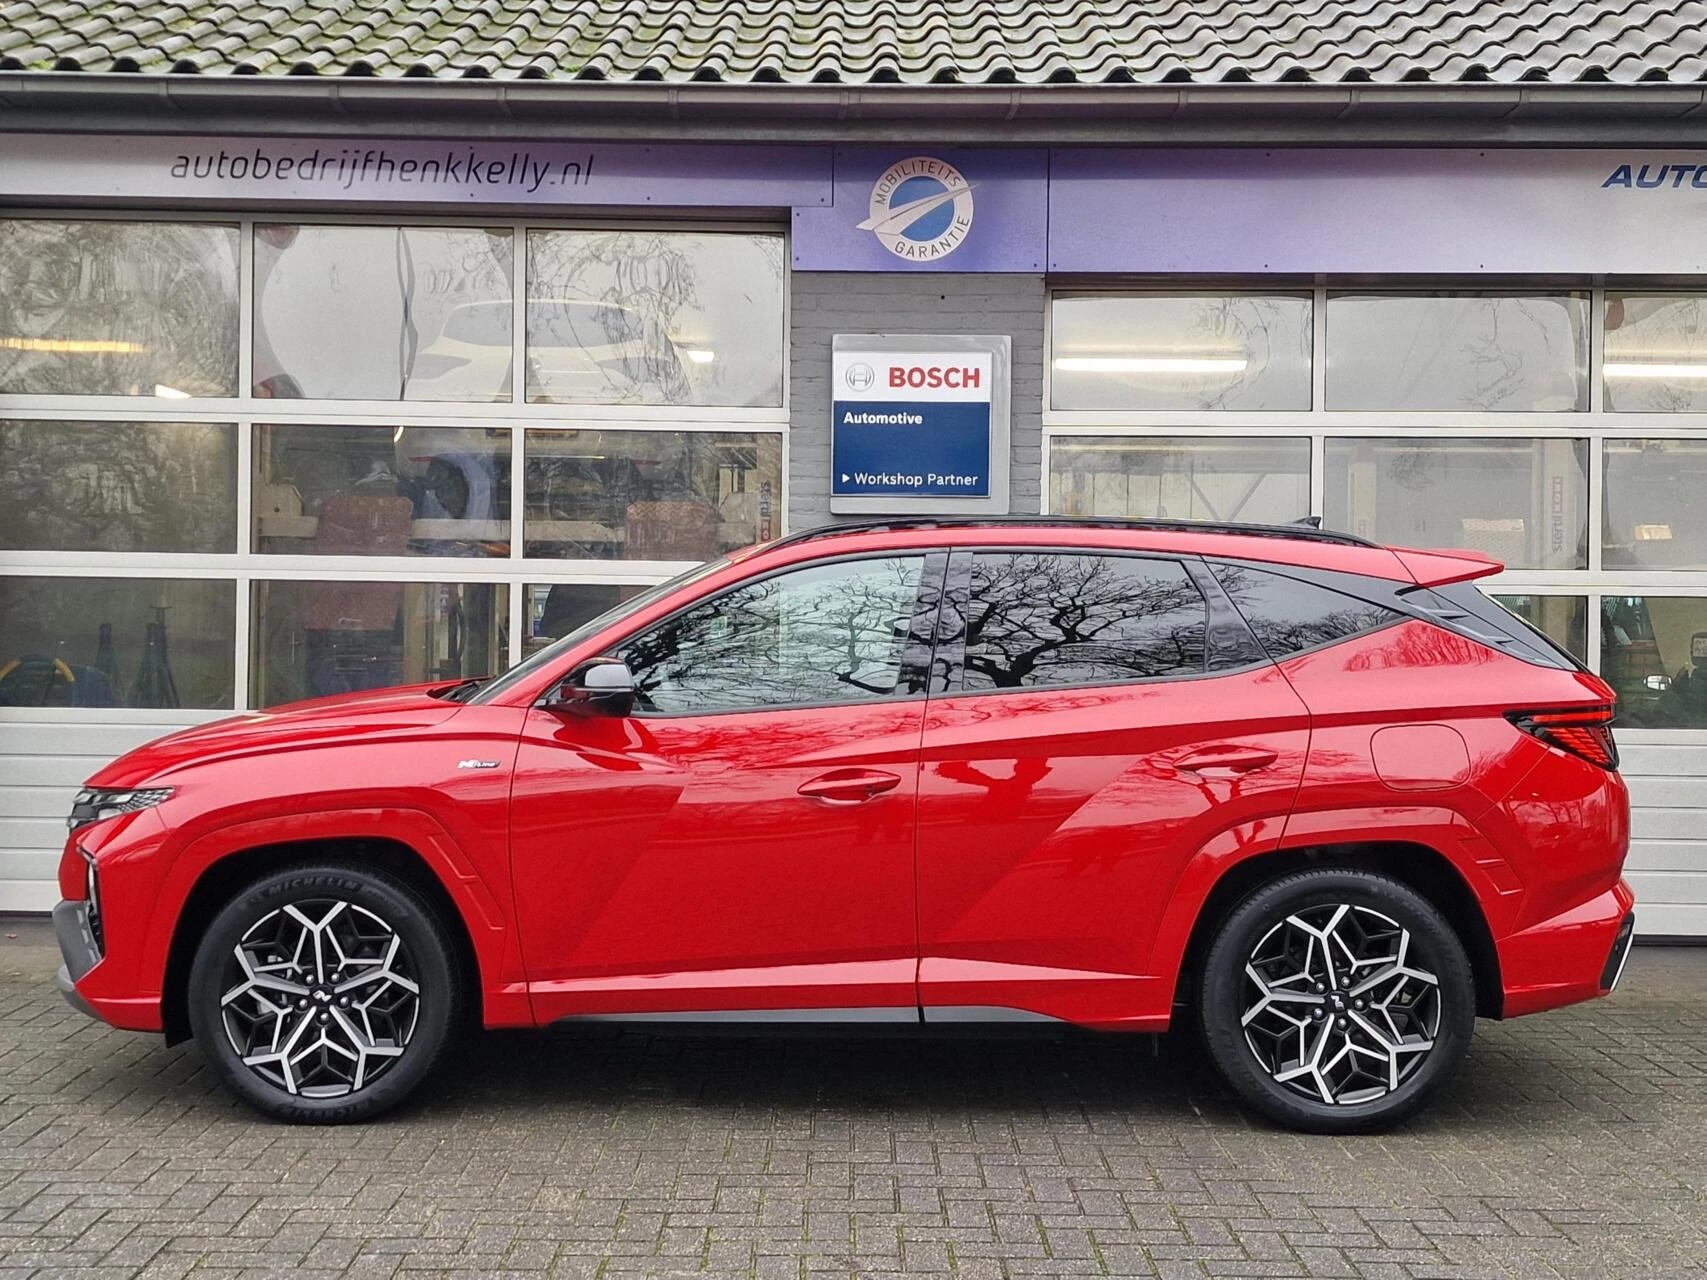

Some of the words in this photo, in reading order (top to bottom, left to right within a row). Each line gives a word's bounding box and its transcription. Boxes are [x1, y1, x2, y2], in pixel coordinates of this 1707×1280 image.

[171, 149, 594, 193] autobedrijfhenkkelly.nl
[875, 160, 961, 205] MOBILITEITS
[894, 215, 970, 257] GARANTIE
[889, 367, 980, 388] BOSCH
[843, 412, 923, 424] Automotive
[854, 472, 923, 487] Workshop
[928, 473, 978, 486] Partner
